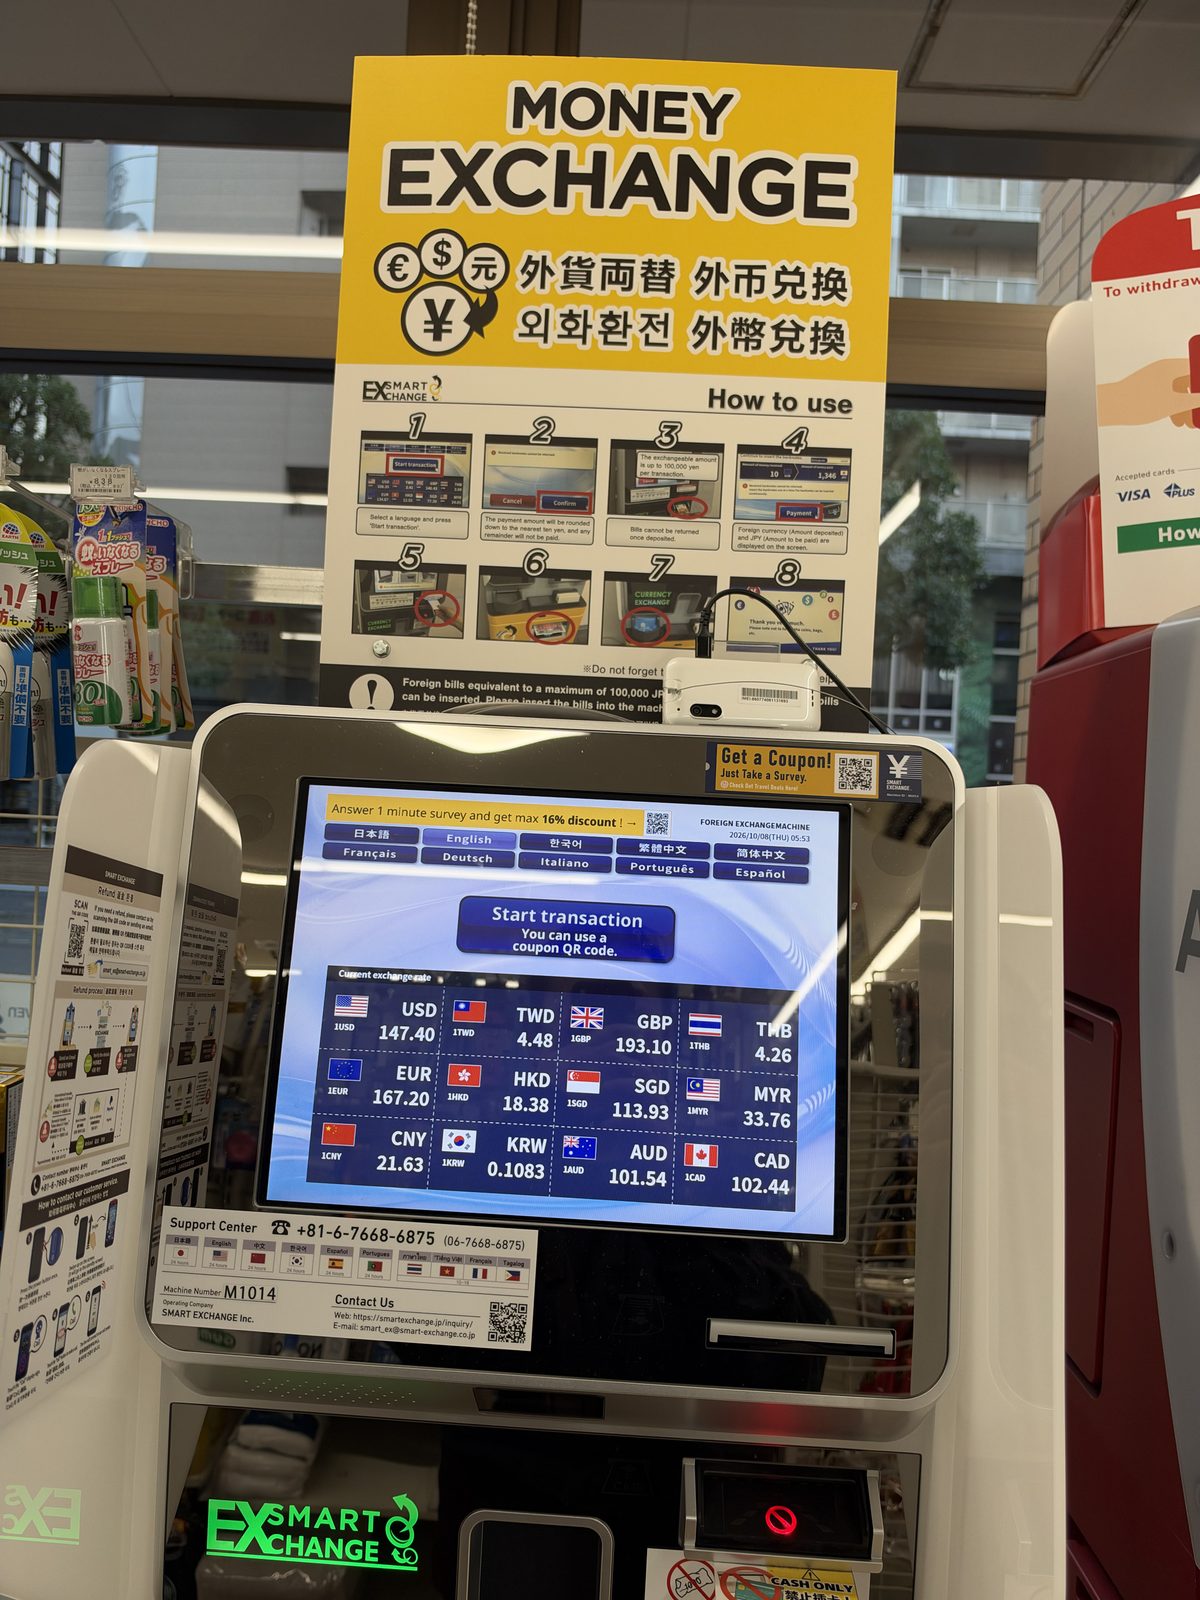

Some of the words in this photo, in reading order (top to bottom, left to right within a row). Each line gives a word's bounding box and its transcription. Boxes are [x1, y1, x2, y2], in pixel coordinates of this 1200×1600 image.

[512, 86, 735, 136] MONEY
[386, 147, 852, 221] EXCHANGE
[519, 255, 677, 296] 外貨両替
[693, 261, 848, 302] 外币兑换
[1104, 286, 1121, 298] To
[518, 308, 672, 346] 외화환전
[691, 314, 846, 356] 外幣兌換
[387, 381, 427, 391] SMART
[708, 388, 764, 411] How
[772, 392, 798, 412] to
[807, 396, 853, 414] use
[409, 413, 426, 439] 1
[530, 416, 555, 444] 2
[655, 421, 682, 449] 3
[782, 427, 809, 453] 4
[1115, 471, 1151, 482] Accepted
[1152, 468, 1175, 477] cards
[1116, 488, 1151, 502] VISA
[1171, 488, 1196, 498] PLUS
[394, 515, 421, 523] language
[786, 510, 812, 518] Payment
[1158, 526, 1200, 543] How
[398, 543, 425, 570] 5
[523, 549, 549, 576] 6
[92, 558, 134, 576] スプレー
[649, 554, 675, 581] 7
[774, 558, 801, 586] 8
[609, 665, 625, 675] not
[627, 665, 658, 677] forget
[403, 677, 441, 690] Foreign
[444, 679, 465, 690] bills
[468, 680, 519, 695] equivalent
[522, 683, 533, 693] to
[545, 685, 593, 696] maximum
[596, 686, 607, 696] of
[610, 687, 649, 700] 100,000
[402, 693, 420, 702] can
[423, 692, 437, 703] be
[439, 694, 480, 705] inserted.
[721, 747, 748, 765] Get
[754, 754, 762, 765] a
[768, 749, 832, 772] Coupon!
[720, 768, 740, 779] Just
[742, 769, 763, 780] Take
[765, 772, 771, 780] a
[774, 770, 807, 784] Survey.
[331, 804, 374, 816] Answer
[377, 806, 383, 816] 1
[387, 807, 427, 818] minute
[429, 811, 467, 823] survey
[469, 811, 491, 821] and
[493, 813, 512, 825] get
[515, 814, 539, 824] max
[542, 814, 565, 825] 16%
[567, 816, 617, 828] discount
[700, 819, 734, 828] FOREIGN
[735, 820, 810, 831] EXCHANGEMACHINE
[354, 829, 390, 840] 日本語
[446, 834, 492, 846] English
[729, 831, 789, 842] 2026/10/08(THU)
[790, 833, 811, 843] 05:53
[549, 838, 582, 849] 한국어
[639, 842, 687, 855] 繁體中文
[343, 848, 397, 861] Français
[442, 852, 493, 864] Deutsch
[736, 848, 786, 860] 简体中文
[540, 857, 589, 869] Italiano
[630, 861, 694, 876] Português
[735, 867, 786, 881] Español
[98, 886, 116, 899] Refund
[74, 899, 89, 910] SCAN
[492, 907, 536, 924] Start
[541, 909, 643, 929] transaction
[521, 928, 546, 940] You
[548, 931, 571, 941] can
[574, 933, 598, 943] use
[600, 935, 607, 943] a
[512, 942, 559, 955] coupon
[562, 944, 582, 955] QR
[584, 944, 618, 957] code.
[338, 969, 372, 979] Current
[373, 971, 412, 982] exchange
[413, 973, 432, 983] rate
[402, 1002, 437, 1018] USD
[517, 1007, 555, 1024] TWD
[637, 1014, 673, 1031] GBP
[756, 1021, 792, 1039] THB
[379, 1025, 435, 1042] 147.40
[517, 1031, 553, 1048] 4.48
[616, 1037, 672, 1055] 193.10
[754, 1046, 792, 1063] 4.26
[396, 1065, 432, 1082] EUR
[514, 1071, 551, 1088] HKD
[634, 1078, 670, 1095] SGD
[754, 1085, 791, 1103] MYR
[372, 1089, 430, 1107] 167.20
[502, 1096, 550, 1113] 18.38
[612, 1102, 669, 1120] 113.93
[743, 1111, 791, 1129] 33.76
[391, 1130, 427, 1148] CNY
[506, 1136, 547, 1154] KRW
[630, 1144, 668, 1161] AUD
[754, 1152, 790, 1169] CAD
[376, 1155, 424, 1173] 21.63
[487, 1161, 545, 1179] 0.1083
[609, 1168, 667, 1187] 101.54
[731, 1176, 790, 1195] 102.44
[170, 1217, 216, 1232] Support
[219, 1220, 258, 1234] Center
[297, 1223, 435, 1246] +81-6-7668-6875
[443, 1234, 525, 1252] (06-7668-6875)
[211, 1239, 232, 1248] English
[326, 1247, 348, 1256] Español
[469, 1257, 492, 1266] Français
[503, 1260, 524, 1269] Tagalog
[164, 1285, 192, 1295] Machine
[193, 1288, 222, 1297] Number
[224, 1285, 276, 1301] M1014
[335, 1294, 377, 1307] Contact
[380, 1297, 394, 1309] Us
[163, 1299, 188, 1308] Operating
[189, 1301, 214, 1309] Company
[162, 1309, 191, 1319] SMART
[193, 1310, 238, 1322] EXCHANGE
[240, 1314, 254, 1323] Inc.
[334, 1311, 351, 1320] Web:
[353, 1313, 474, 1329] https://smartexchange.jp/inquiry/
[333, 1322, 359, 1331] E-mail:
[360, 1324, 476, 1340] smart_ex@smart-exchange.co.jp
[268, 1503, 380, 1533] SMART
[770, 1577, 810, 1589] CASH
[813, 1581, 853, 1593] ONLY
